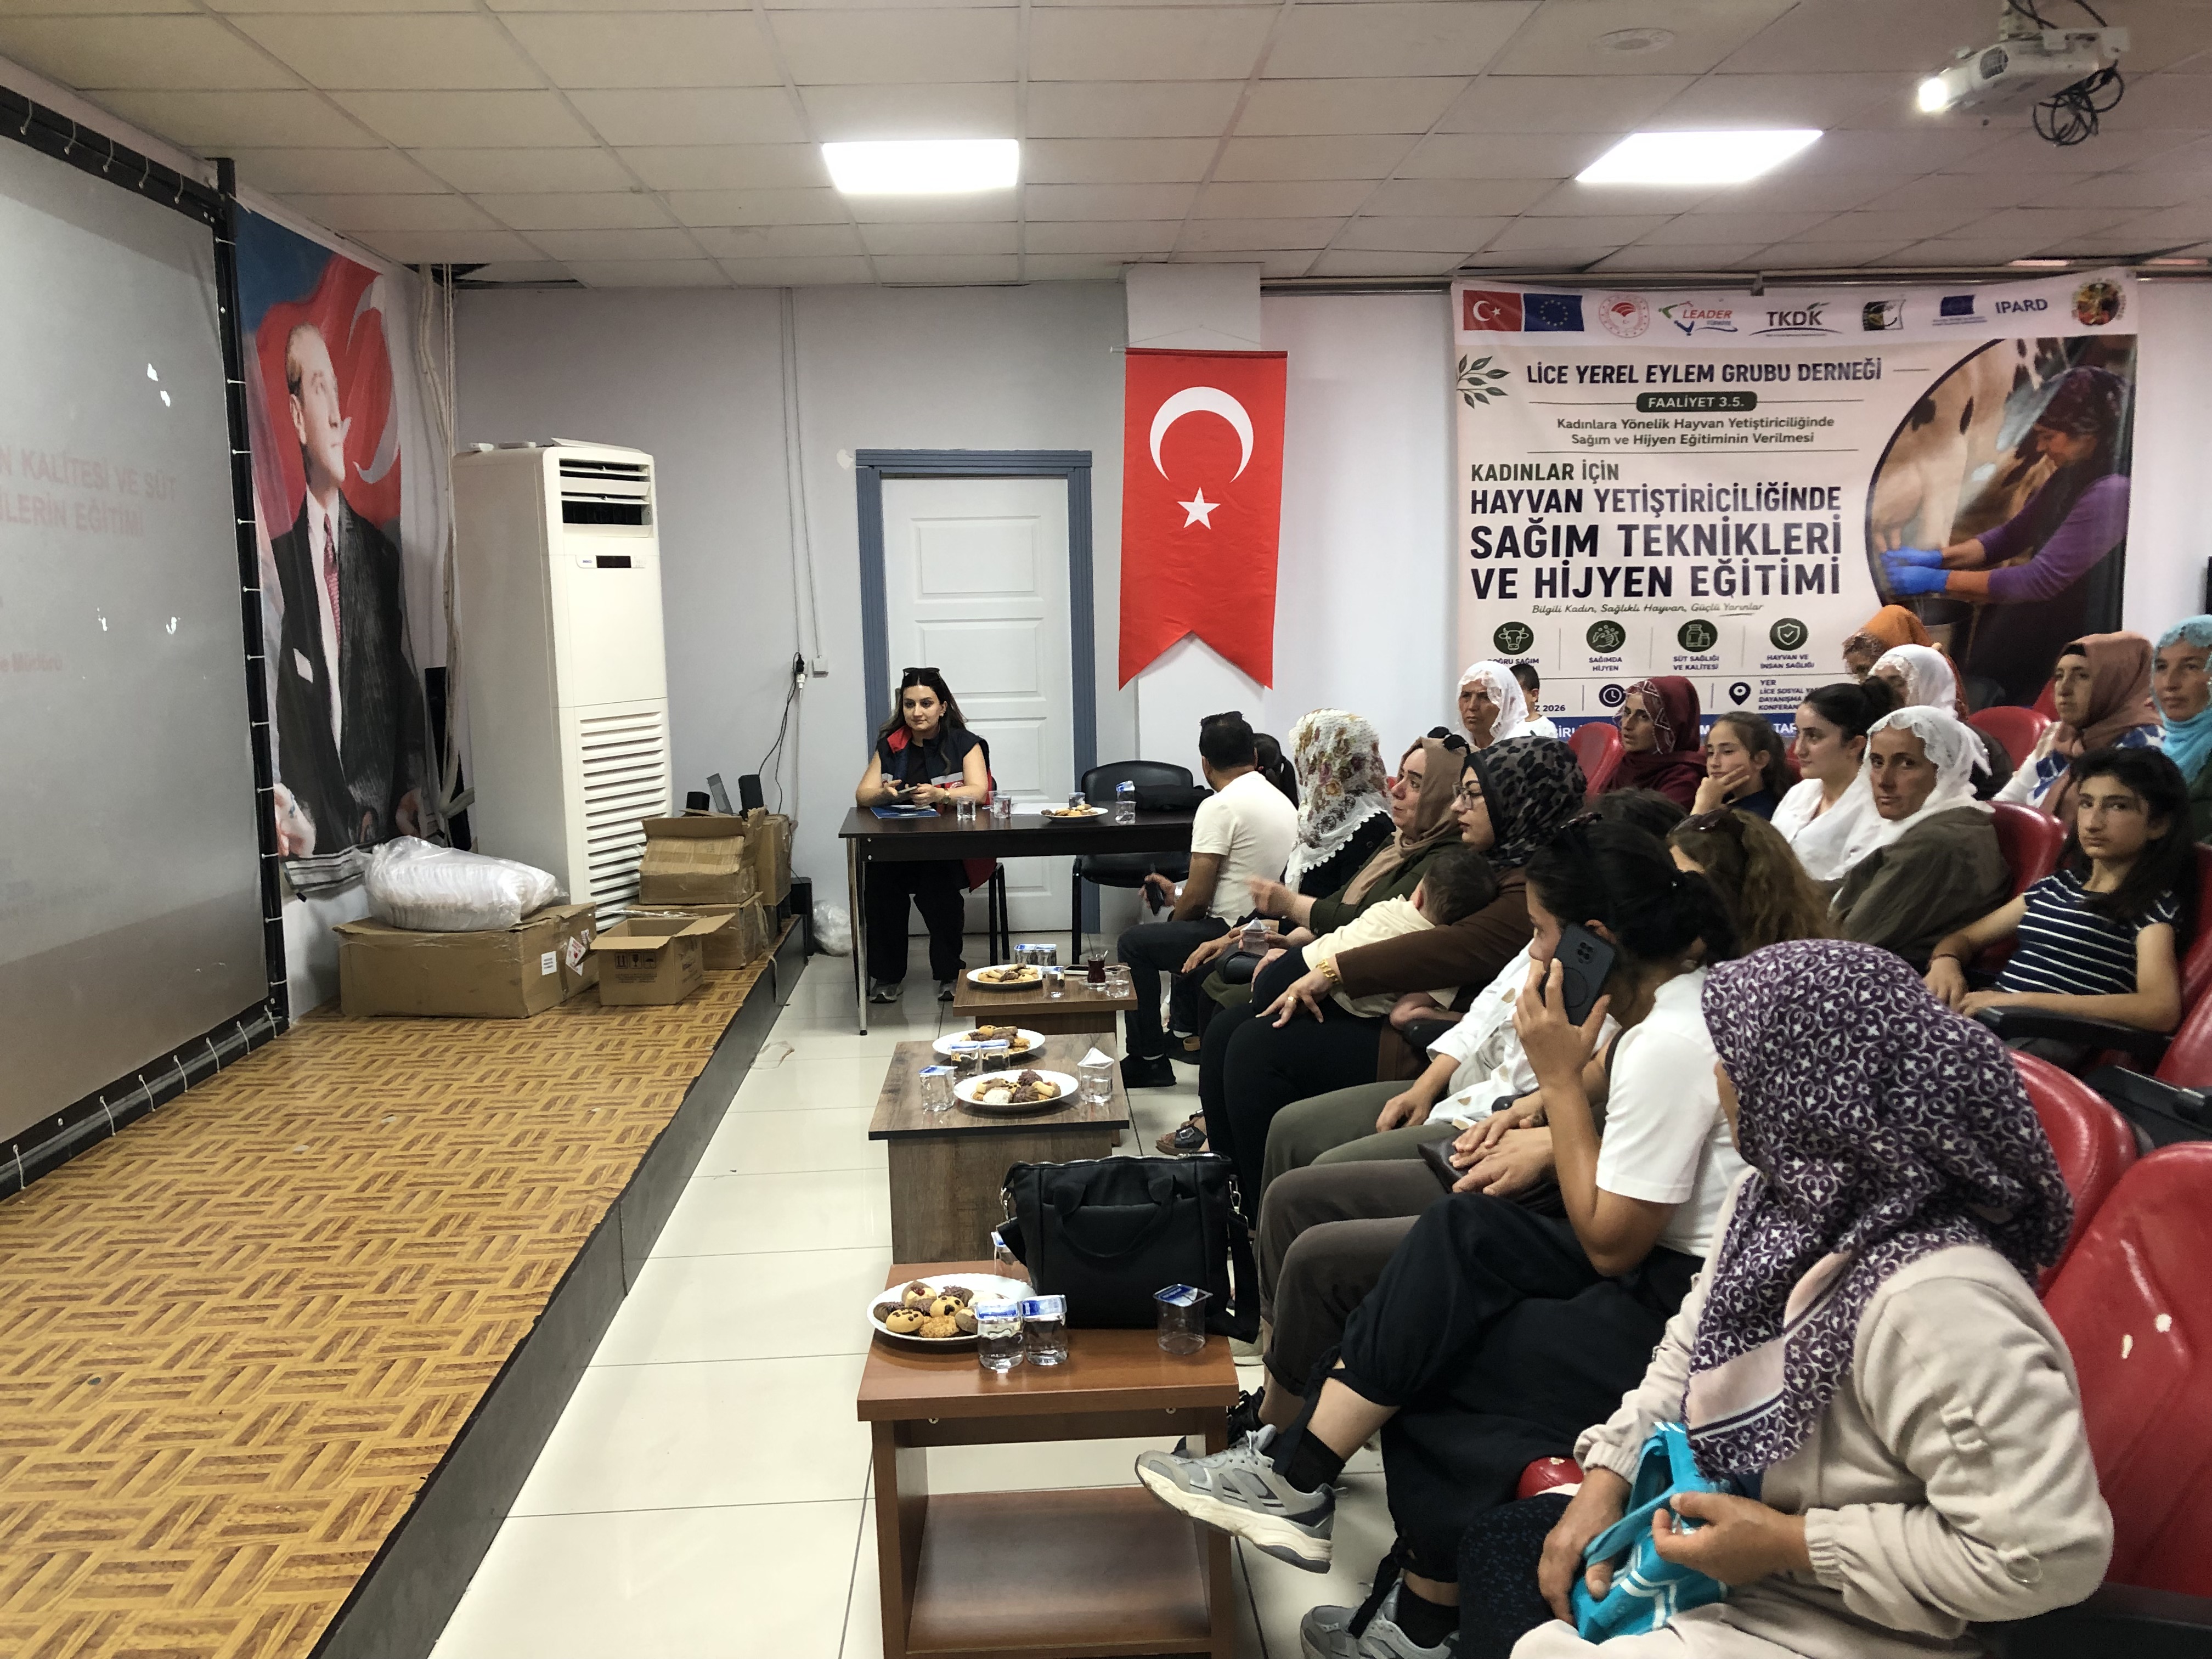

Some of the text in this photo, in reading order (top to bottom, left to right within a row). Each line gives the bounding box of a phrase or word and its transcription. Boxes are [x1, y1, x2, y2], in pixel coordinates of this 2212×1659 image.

[1683, 309, 1733, 319] LEADER
[1995, 298, 2048, 314] IPARD
[1766, 311, 1823, 326] TKDK
[1527, 358, 1881, 384] LİCE YEREL EYLEM GRUBU DERNEĞİ
[1648, 396, 1745, 408] FAALİYET 3.5.
[1558, 417, 1835, 431] Kadınlara Yönelik Hayvan Yetiştiriciliğinde
[1571, 432, 1814, 447] Sağım ve Hijyen Eğitiminin Verilmesi
[114, 464, 139, 495] VE
[1471, 459, 1619, 484] KADINLAR İÇİN
[1471, 482, 1841, 518] HAYVAN YETİŞTİRİCİLİĞİNDE
[1470, 514, 1842, 559] SAĞIM TEKNİKLERİ
[1471, 556, 1840, 599] VE HİJYEN EĞİTİMİ
[1532, 605, 1562, 616] Bilgili
[1565, 605, 1597, 613] Kadın,
[1601, 603, 1640, 614] Sağlıklı
[1644, 603, 1687, 614] Hayvan,
[1691, 603, 1720, 613] Güçlü
